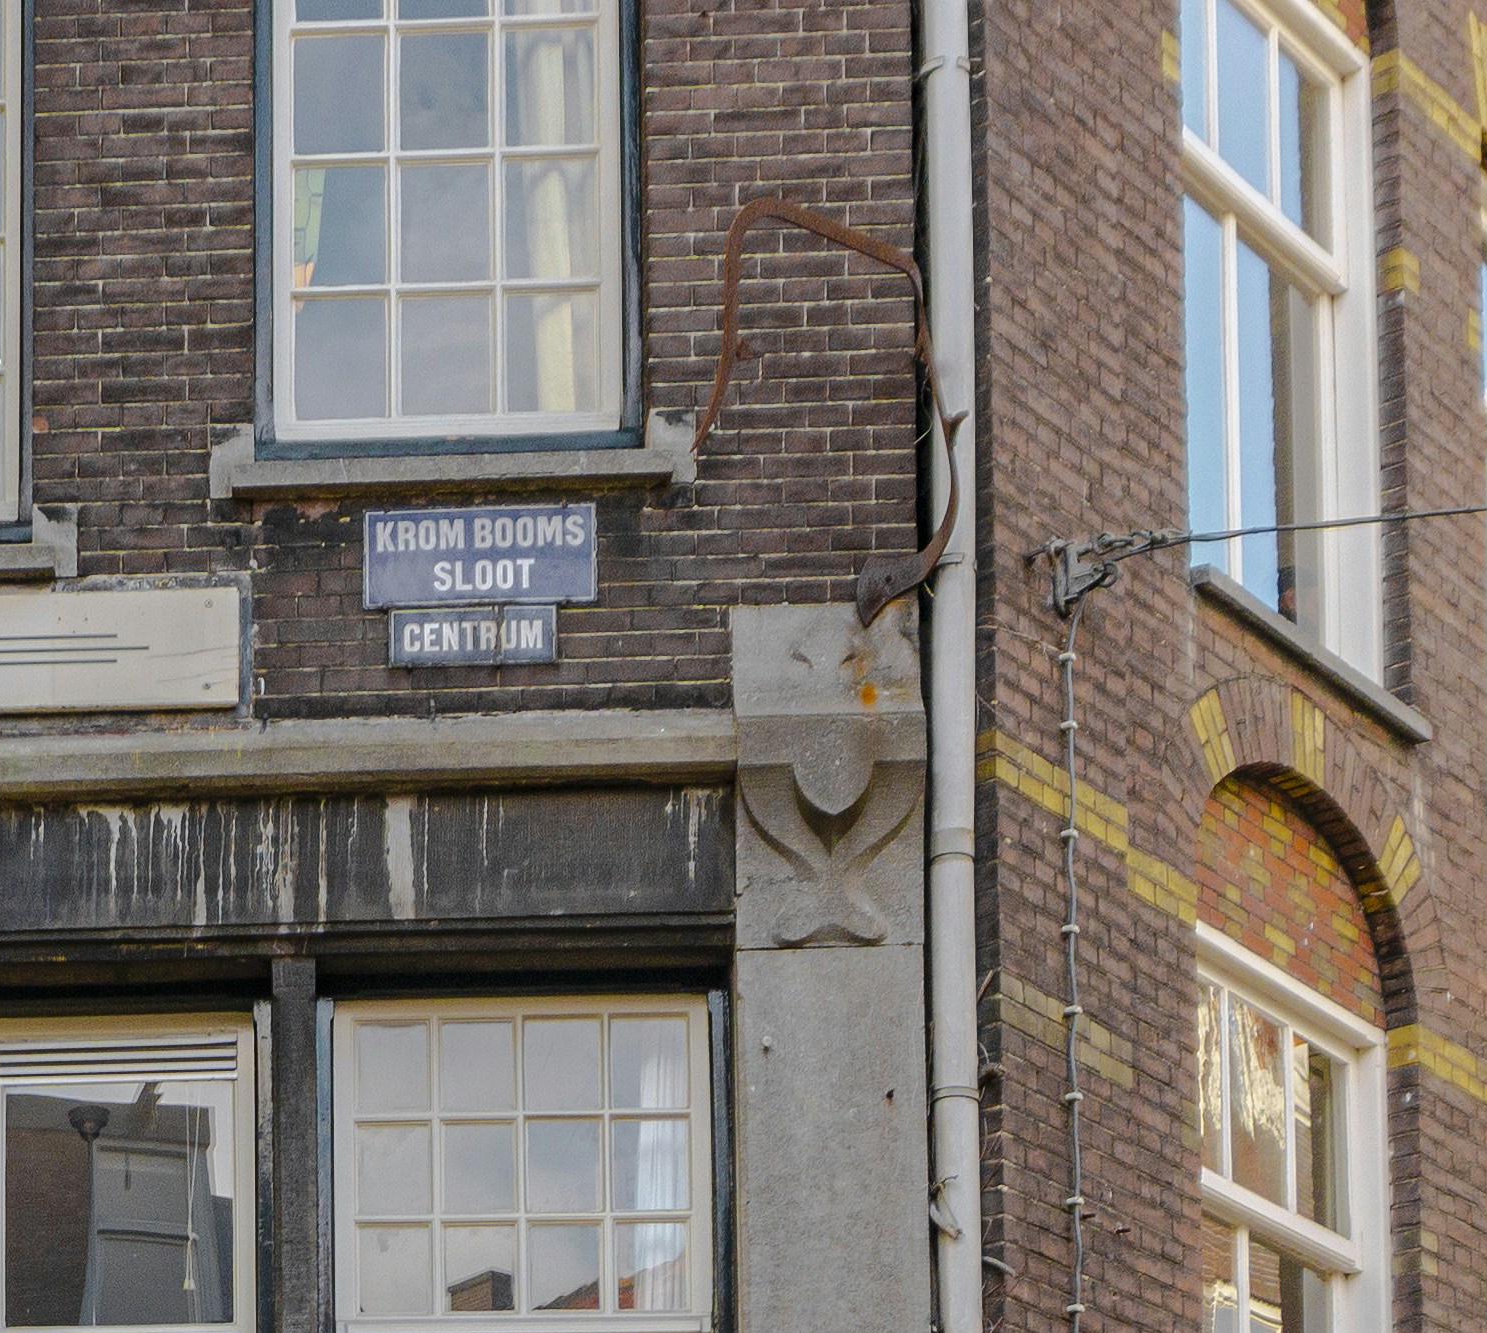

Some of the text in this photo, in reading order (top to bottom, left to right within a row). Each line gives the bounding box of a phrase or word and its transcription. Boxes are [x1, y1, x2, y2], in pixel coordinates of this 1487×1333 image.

[375, 514, 586, 553] KROM BOOMS
[433, 558, 536, 592] SLOOT
[402, 618, 544, 653] CENTRUM
